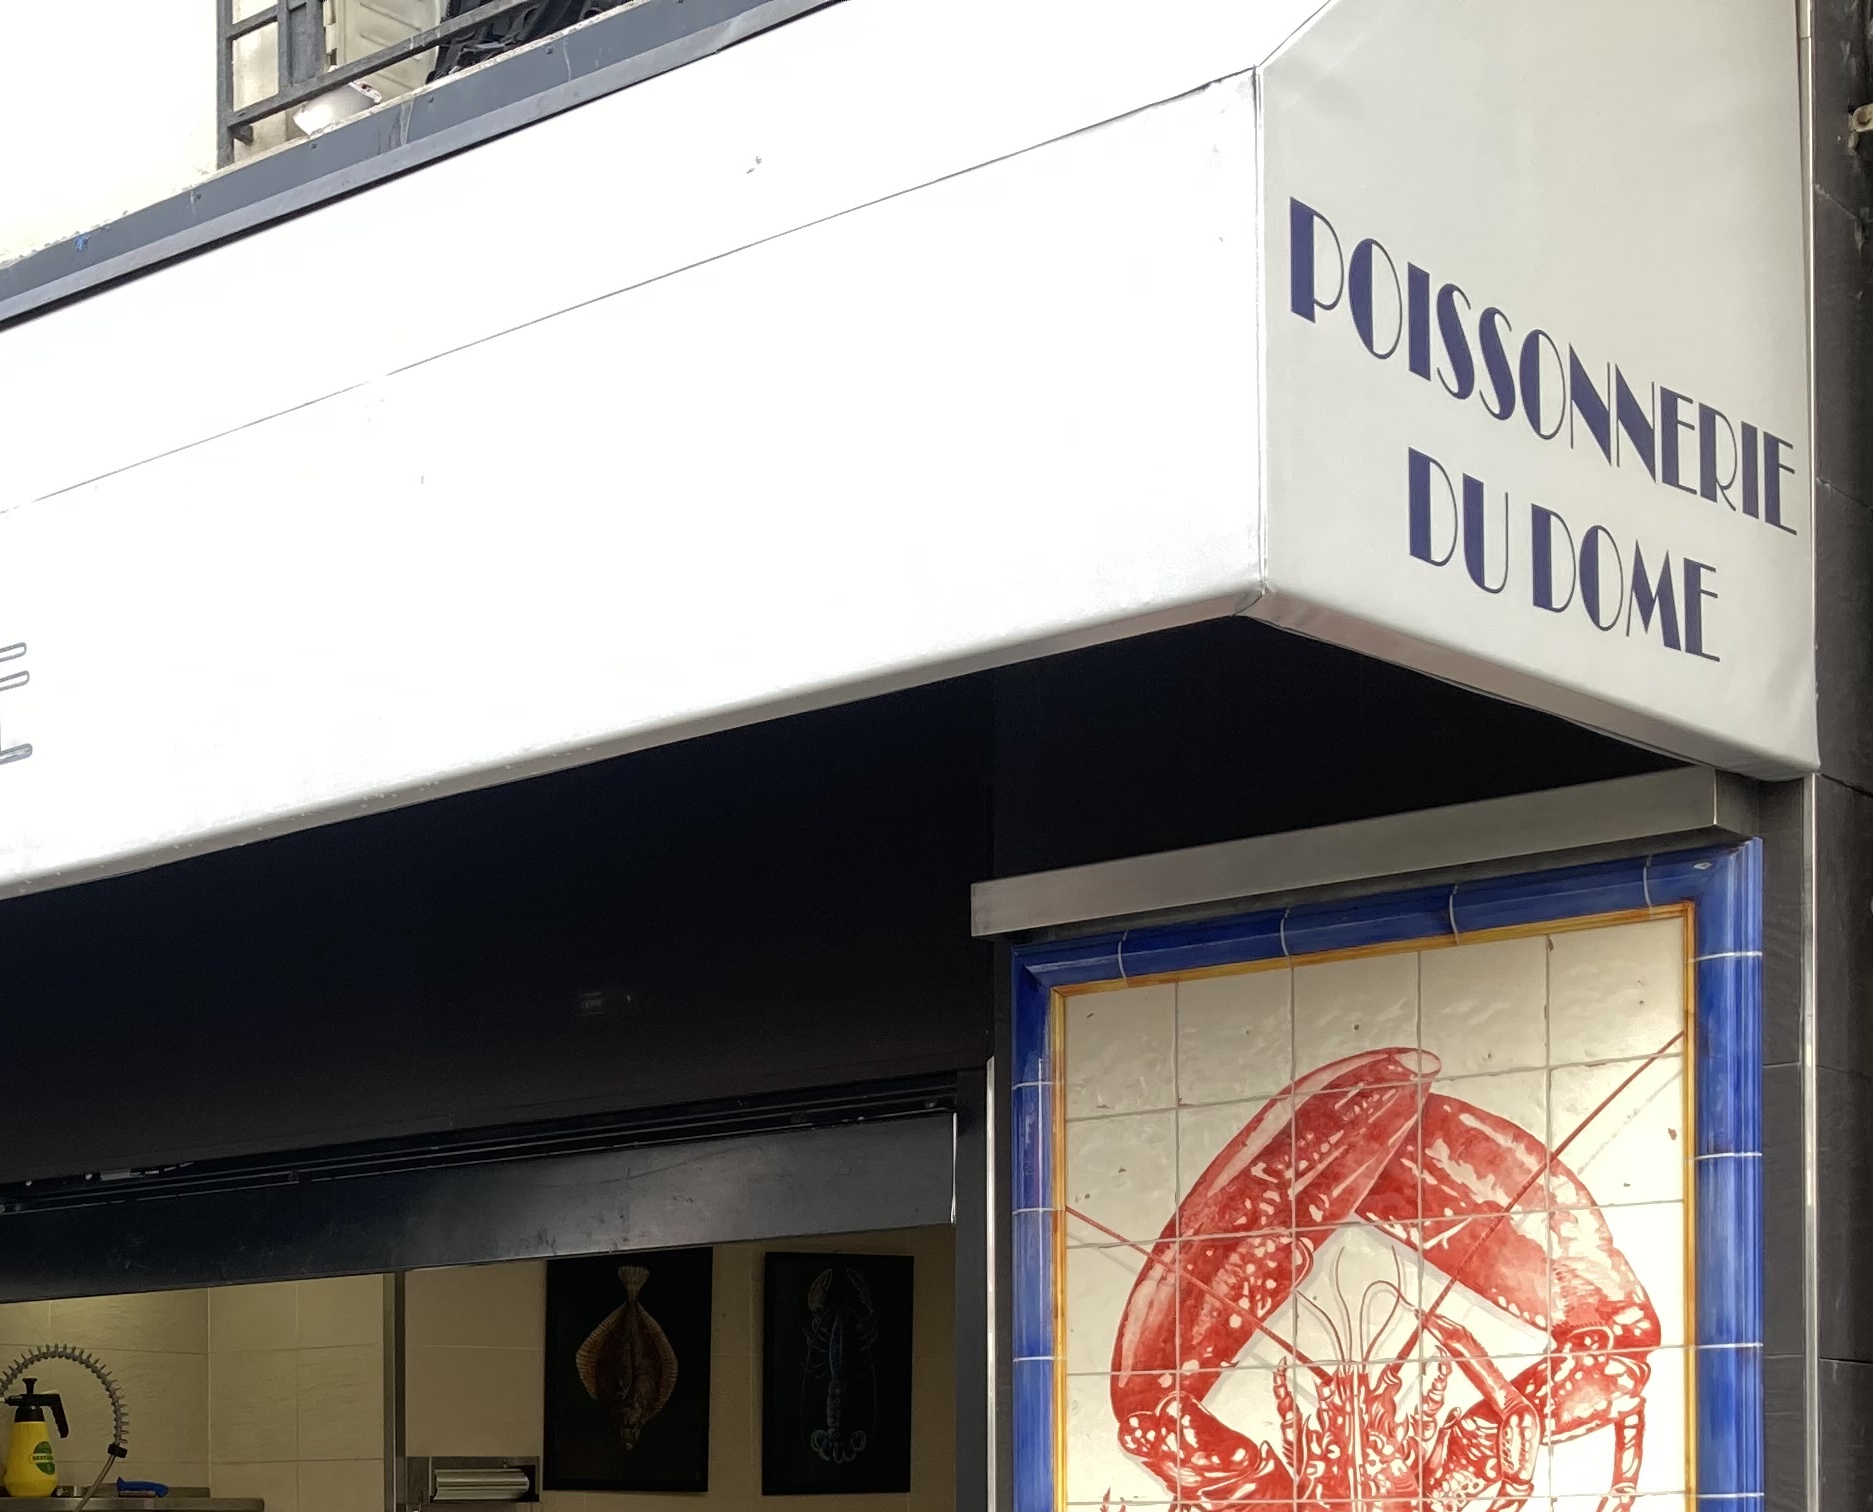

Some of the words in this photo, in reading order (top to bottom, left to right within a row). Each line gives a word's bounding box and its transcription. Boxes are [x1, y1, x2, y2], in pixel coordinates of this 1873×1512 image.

[1289, 196, 1798, 536] POISSONNERIE
[1408, 447, 1510, 594] DU
[1530, 503, 1721, 662] DOME
